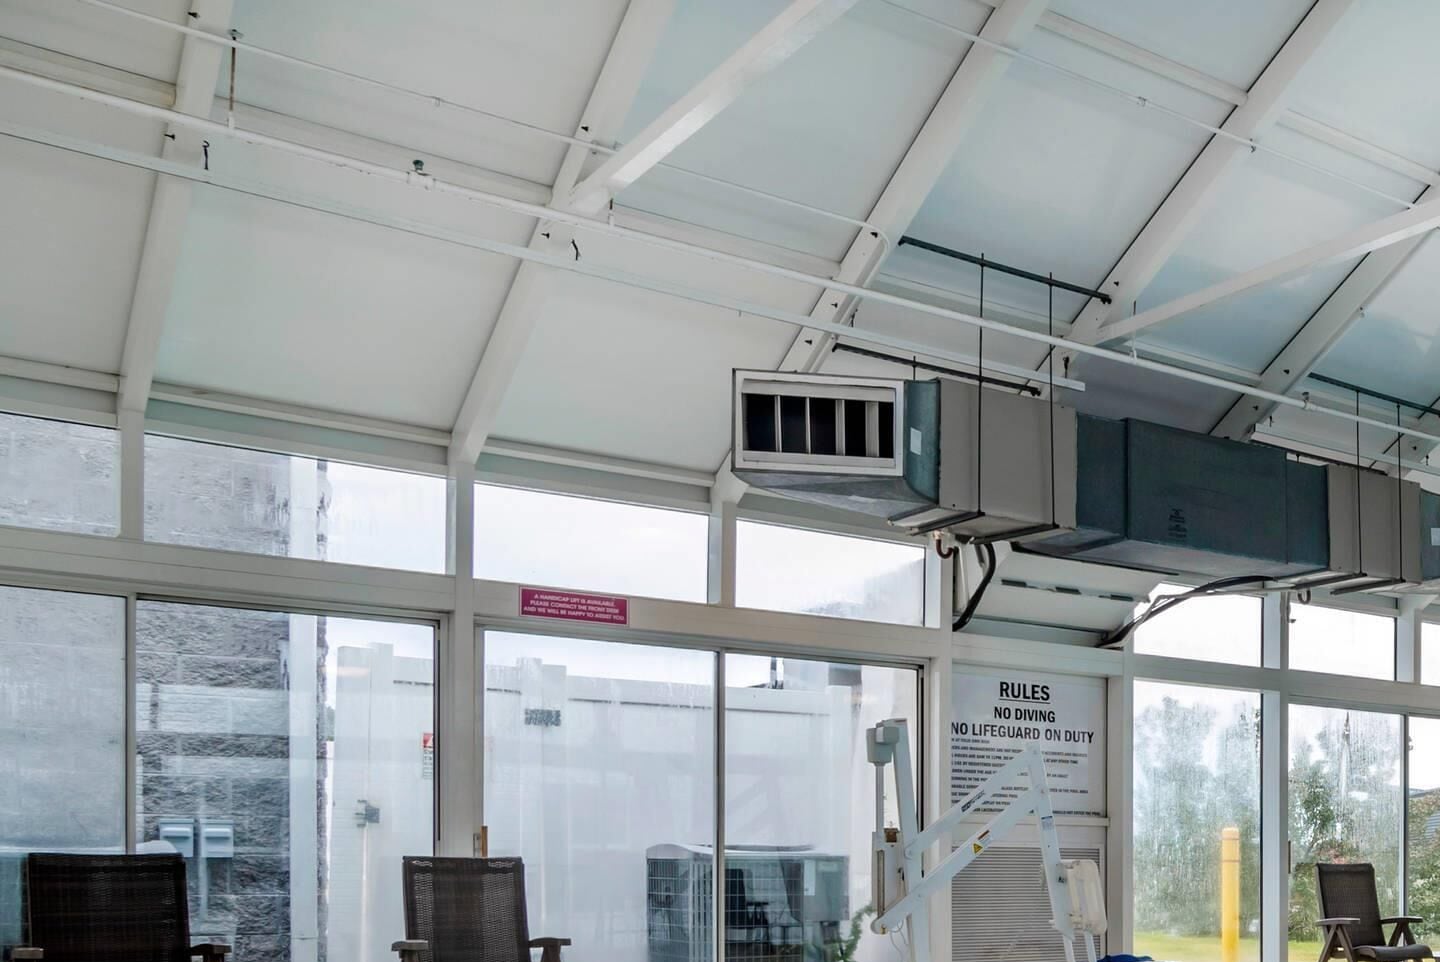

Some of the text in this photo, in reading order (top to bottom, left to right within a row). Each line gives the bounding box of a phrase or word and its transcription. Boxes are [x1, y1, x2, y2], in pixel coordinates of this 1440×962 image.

[999, 681, 1050, 701] RULES
[994, 706, 1056, 723] NO DIVING
[951, 722, 1094, 744] NO LIFEGUARD ON DUTY
